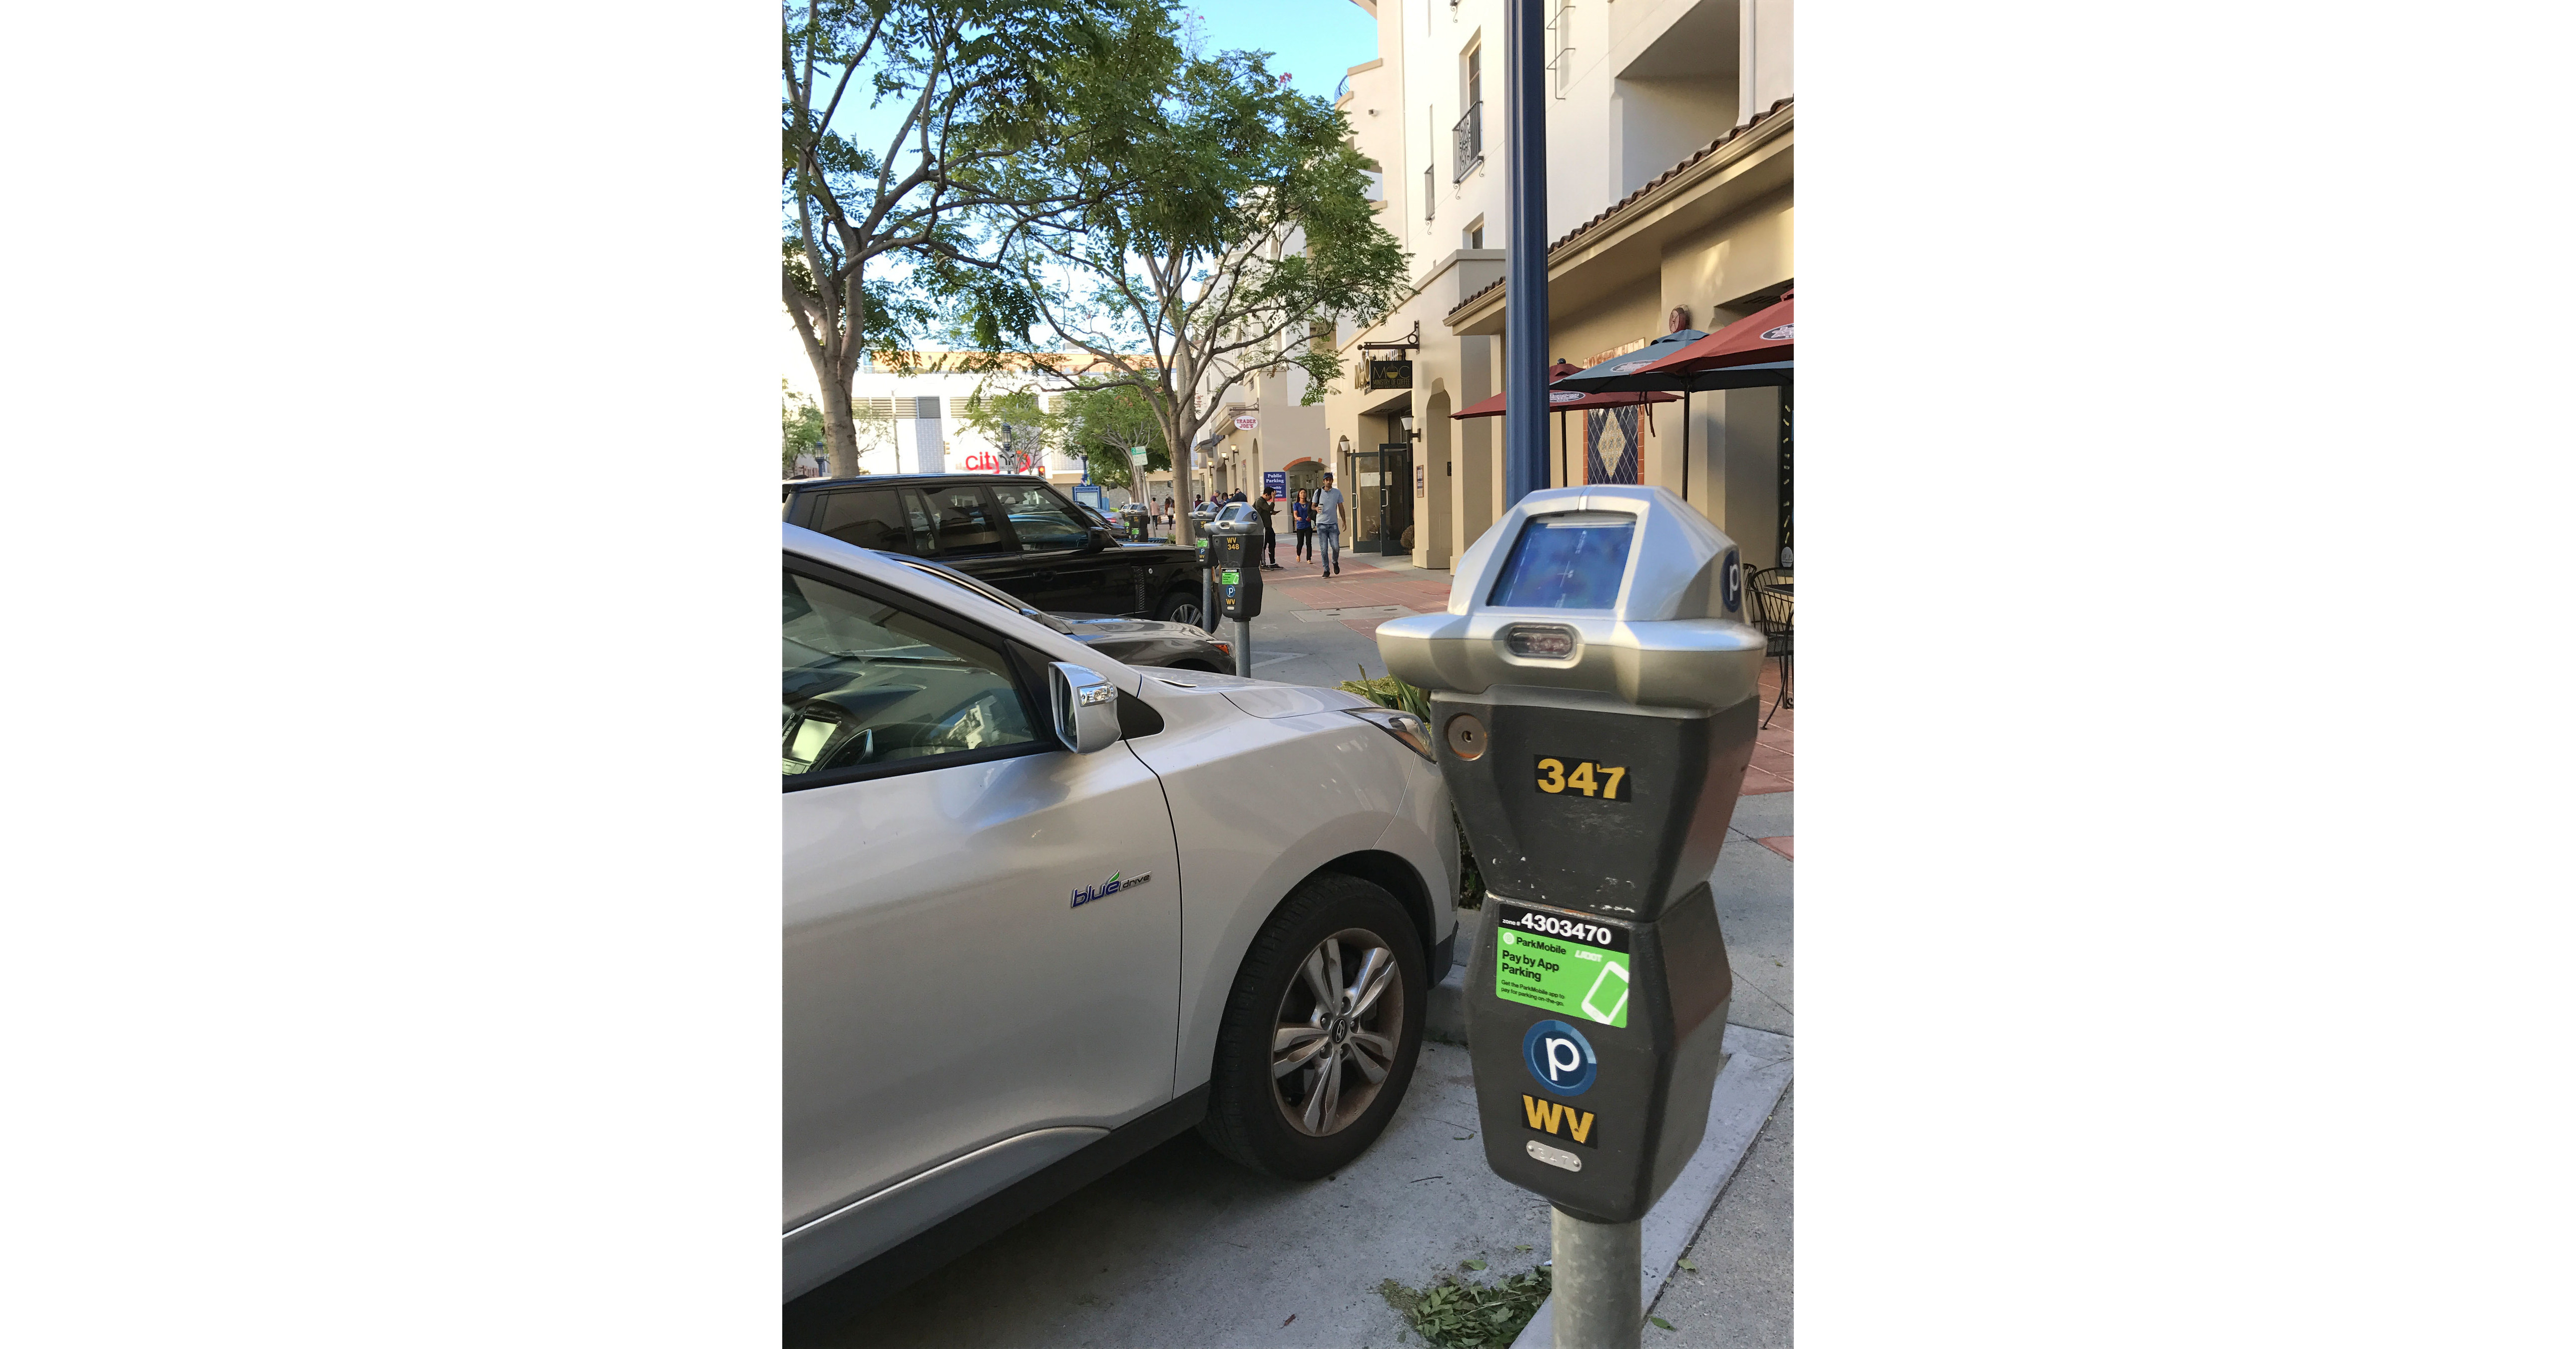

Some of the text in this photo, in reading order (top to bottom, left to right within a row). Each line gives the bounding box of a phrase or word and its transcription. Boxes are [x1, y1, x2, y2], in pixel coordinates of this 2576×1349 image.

[1373, 366, 1410, 379] MOC
[966, 452, 1000, 474] city
[1537, 758, 1626, 799] 347
[1072, 874, 1150, 908] blue drive
[1521, 913, 1612, 944] 4303470
[1516, 936, 1566, 955] ParkMobile
[1502, 949, 1559, 973] Pay by App
[1502, 962, 1541, 982] Parking
[1518, 991, 1537, 1000] parking
[1538, 996, 1564, 1006] on-the-go.
[1520, 983, 1548, 995] ParkMobile
[1523, 1094, 1594, 1144] WV
[1538, 1148, 1568, 1165] 347
